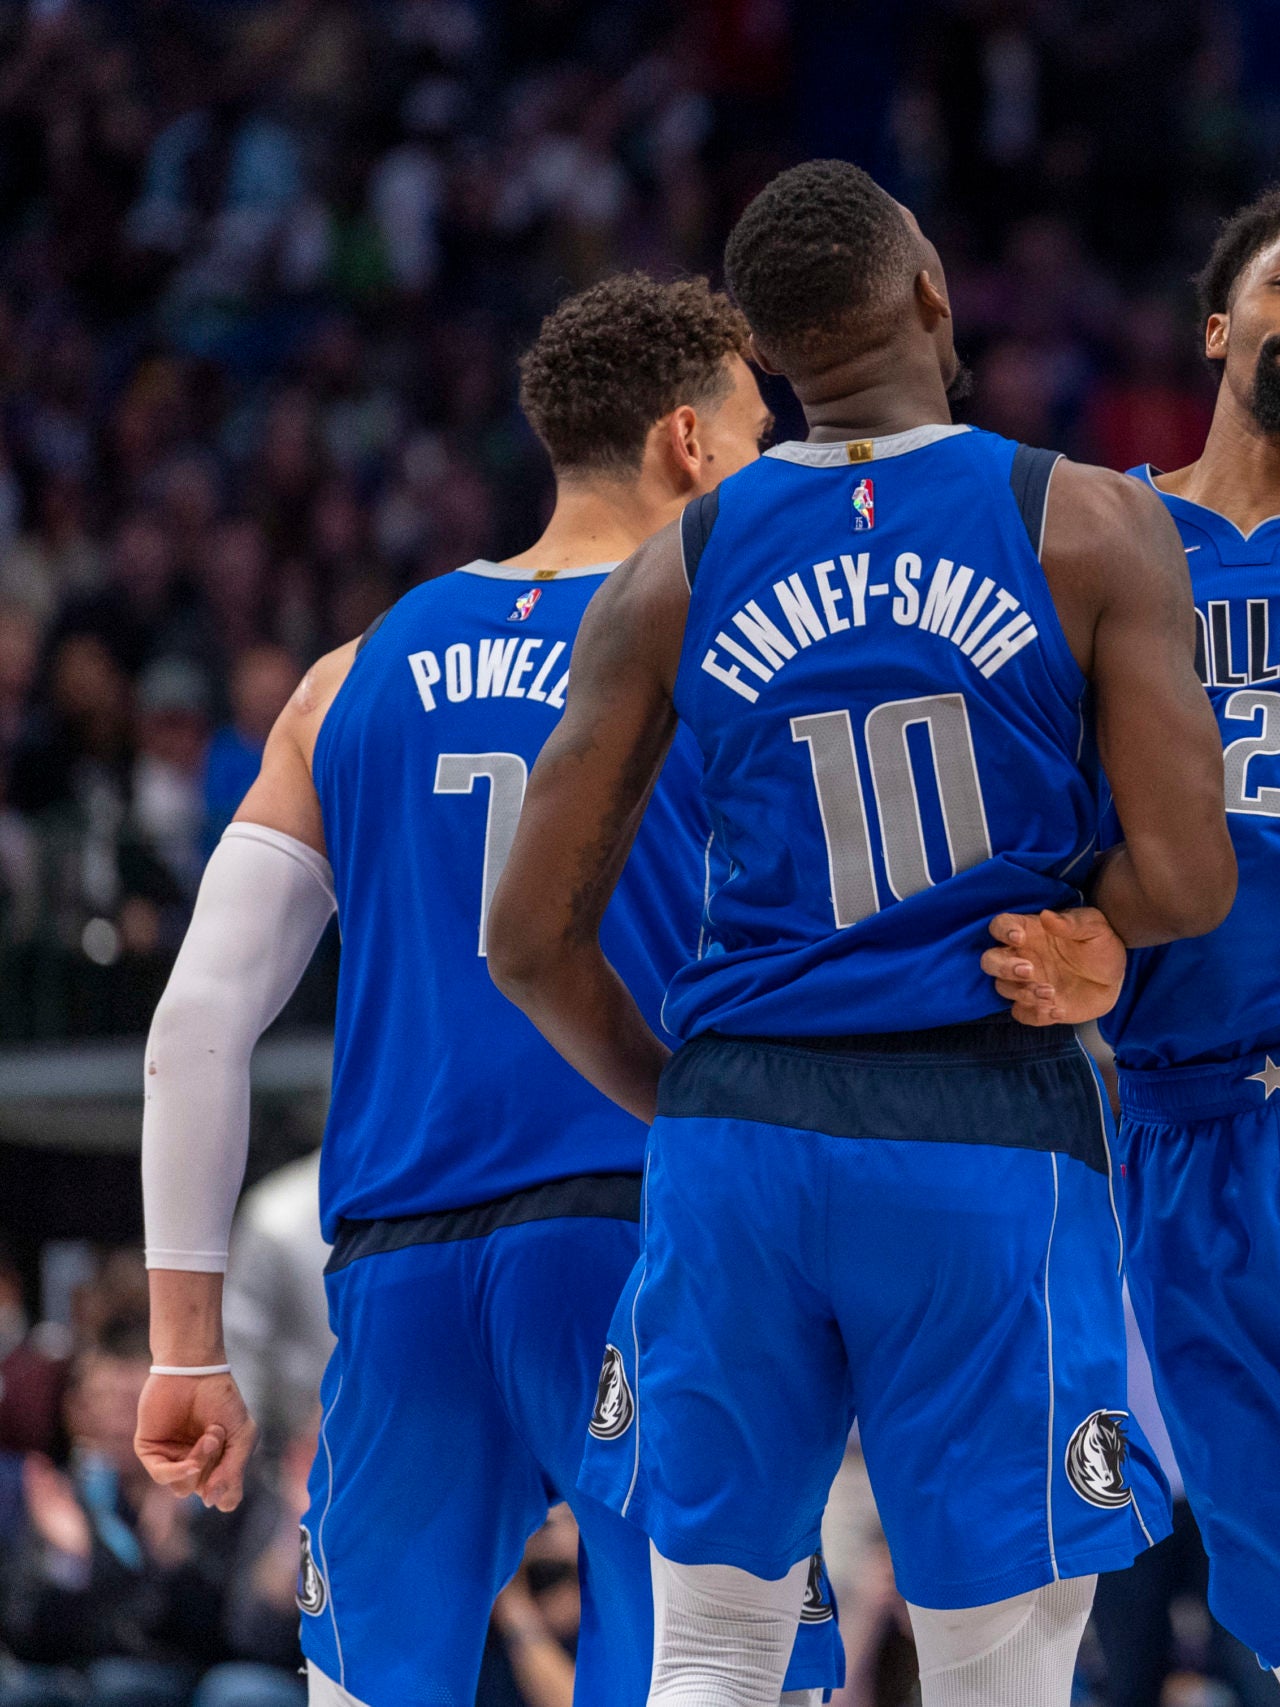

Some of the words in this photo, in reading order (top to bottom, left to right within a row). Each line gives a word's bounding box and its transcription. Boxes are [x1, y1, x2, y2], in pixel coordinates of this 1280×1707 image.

[701, 552, 1039, 704] FINNEY-SMITH
[432, 751, 528, 958] 7
[789, 692, 993, 930] 10
